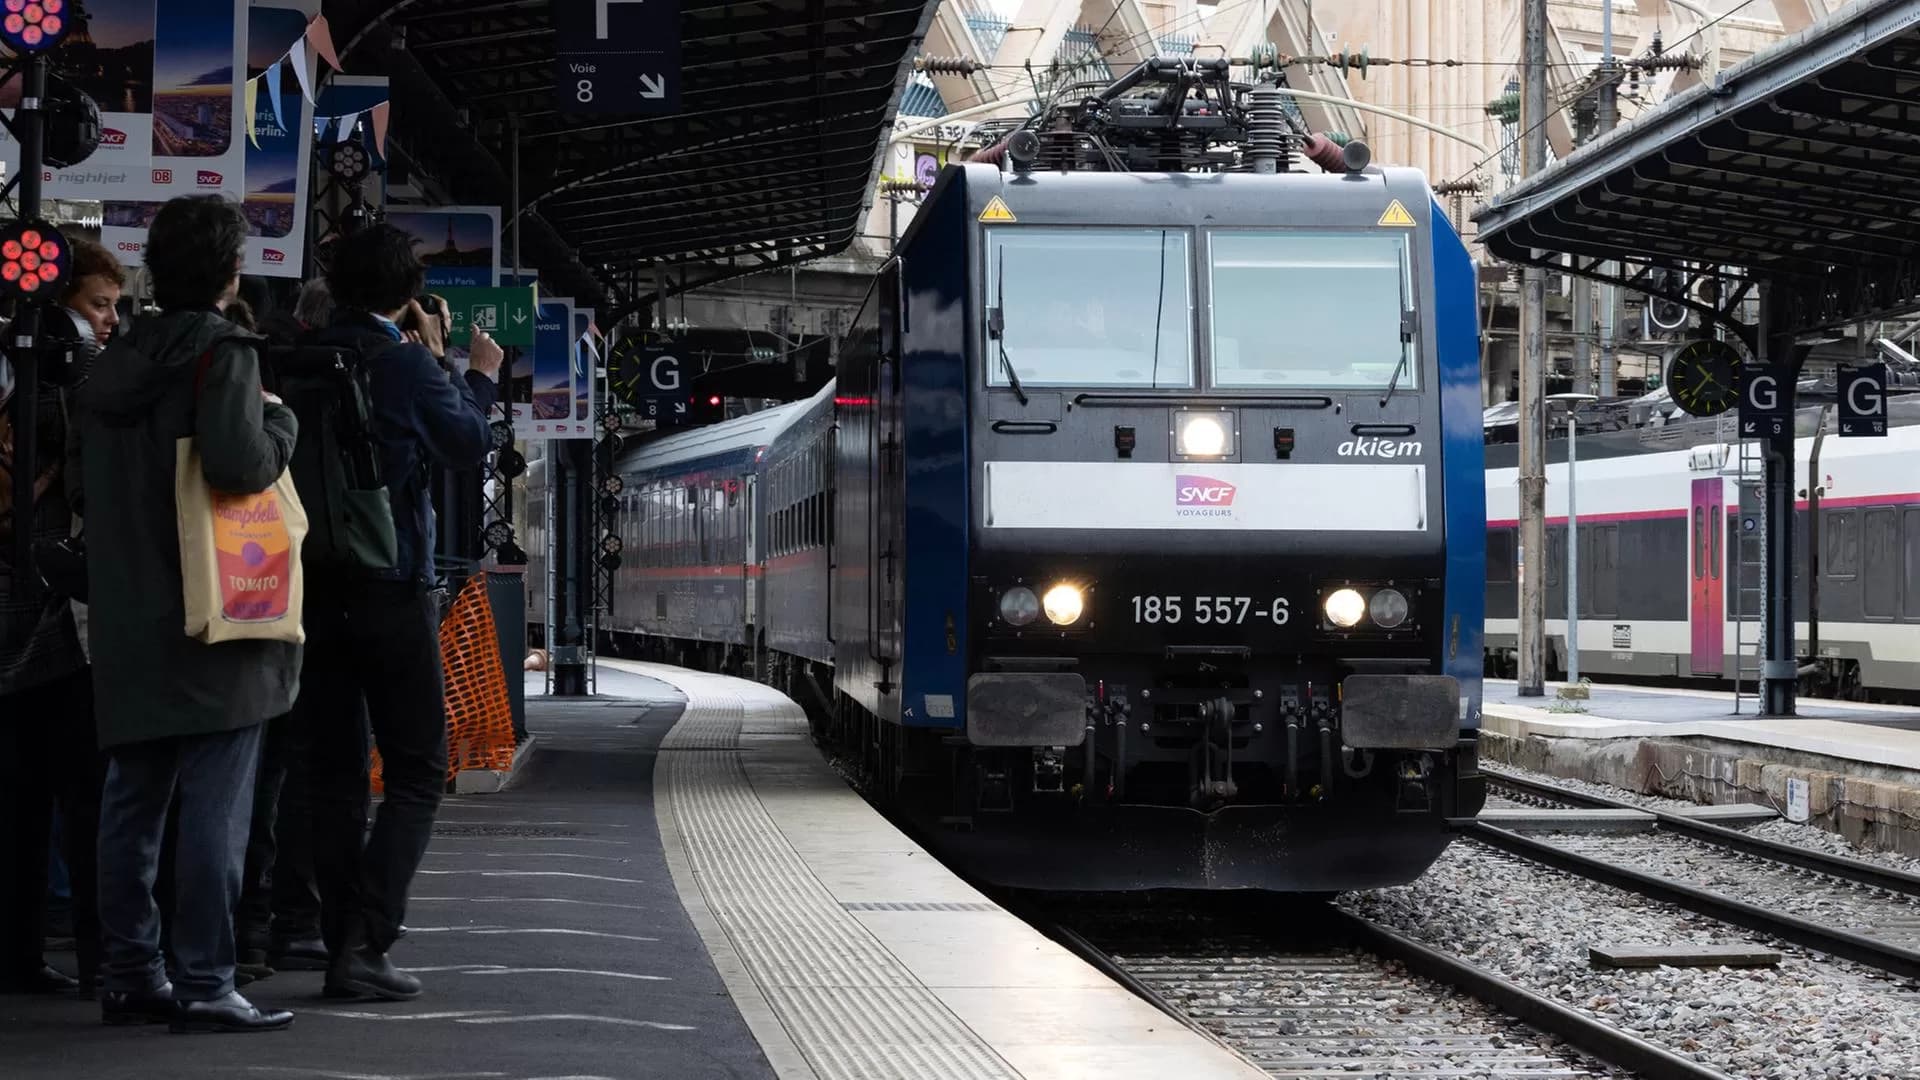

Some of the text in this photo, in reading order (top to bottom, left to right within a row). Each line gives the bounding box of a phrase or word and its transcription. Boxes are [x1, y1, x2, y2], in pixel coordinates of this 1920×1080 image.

[569, 63, 597, 73] Voie
[576, 79, 593, 103] 8
[254, 125, 286, 137] erlin.
[57, 172, 127, 185] nightjet
[155, 171, 170, 181] DB
[650, 355, 680, 391] G
[1749, 375, 1777, 410] G
[1847, 377, 1882, 416] G
[648, 404, 657, 415] 8
[1773, 423, 1782, 434] 9
[1178, 486, 1233, 502] SNCF
[1176, 509, 1233, 517] VOYAGEURS
[229, 575, 279, 592] TOMATO
[1132, 595, 1290, 625] 185 557-6
